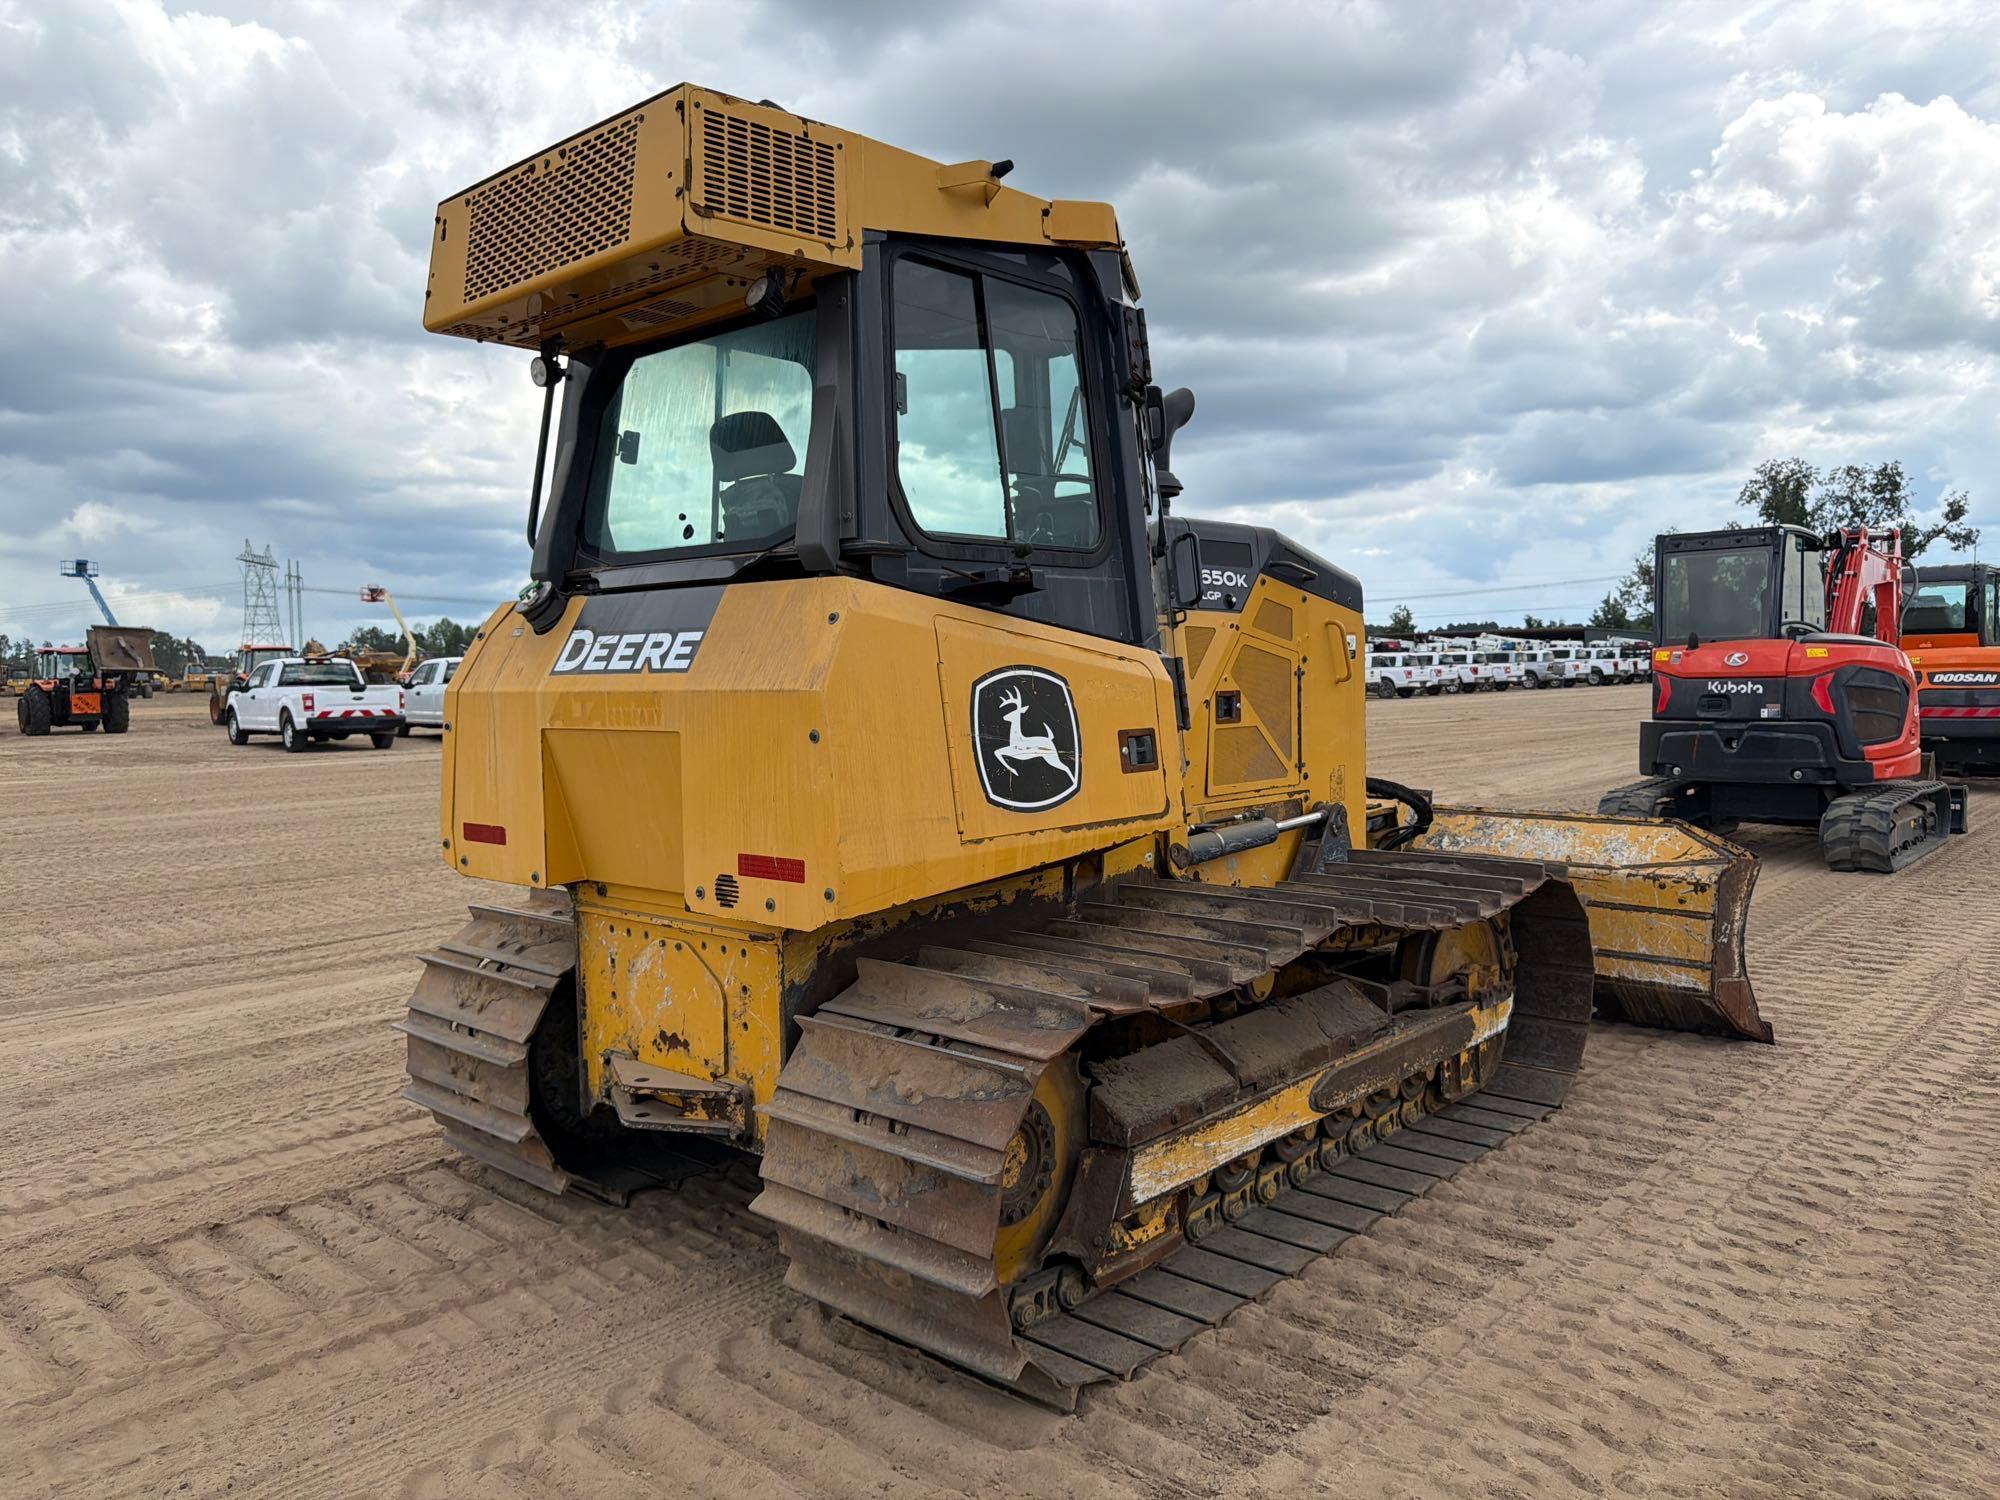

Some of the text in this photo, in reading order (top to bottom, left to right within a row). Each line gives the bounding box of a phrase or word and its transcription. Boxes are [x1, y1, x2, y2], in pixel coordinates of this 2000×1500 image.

[554, 630, 703, 671] DEERE
[1932, 673, 1998, 683] DOOSAN
[1708, 681, 1764, 694] Kubota
